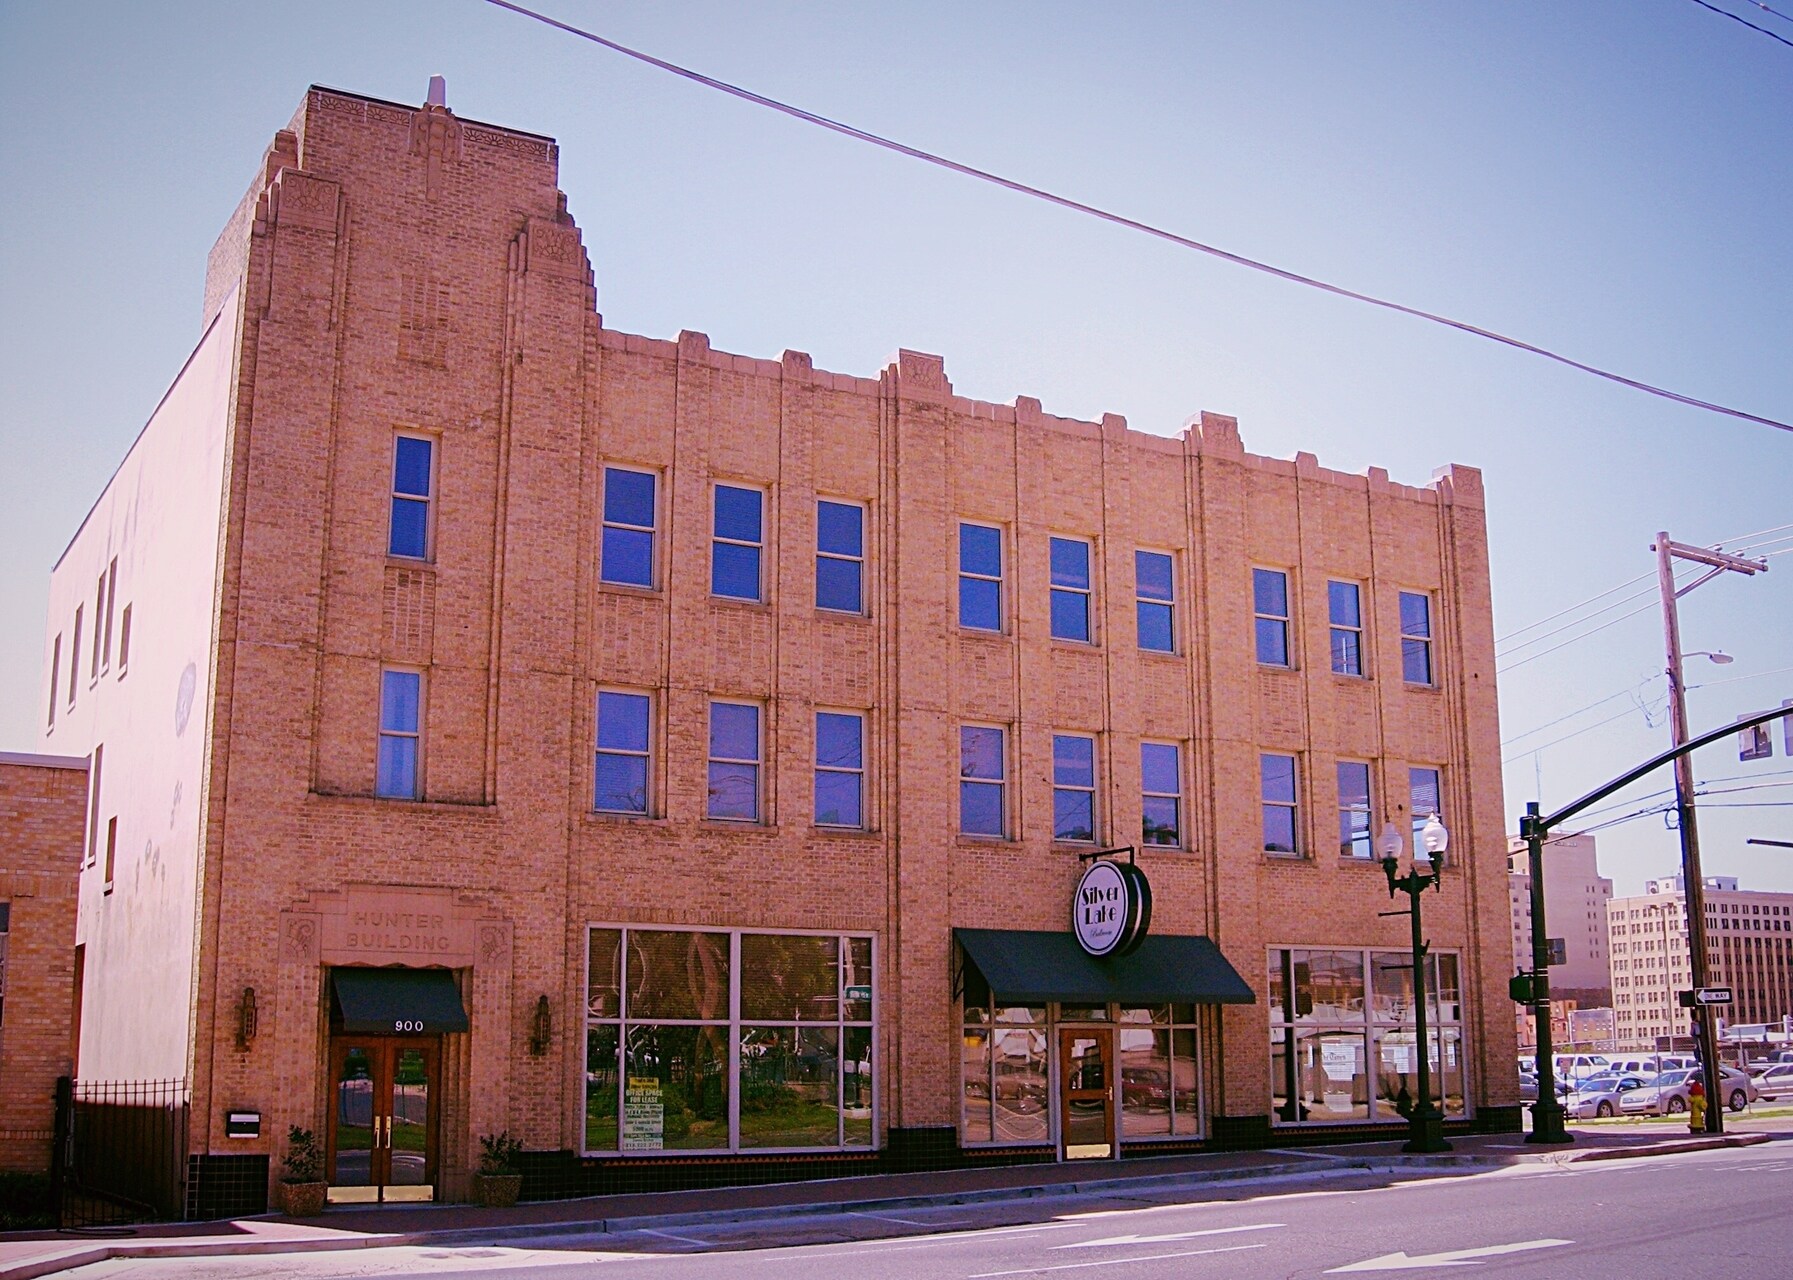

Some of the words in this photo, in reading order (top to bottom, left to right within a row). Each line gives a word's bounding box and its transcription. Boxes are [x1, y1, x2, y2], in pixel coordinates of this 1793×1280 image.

[1082, 886, 1118, 906] Silver
[354, 911, 444, 930] HUNTER
[1085, 905, 1117, 925] Lake
[346, 933, 450, 950] BUILDING
[395, 1020, 424, 1032] 900
